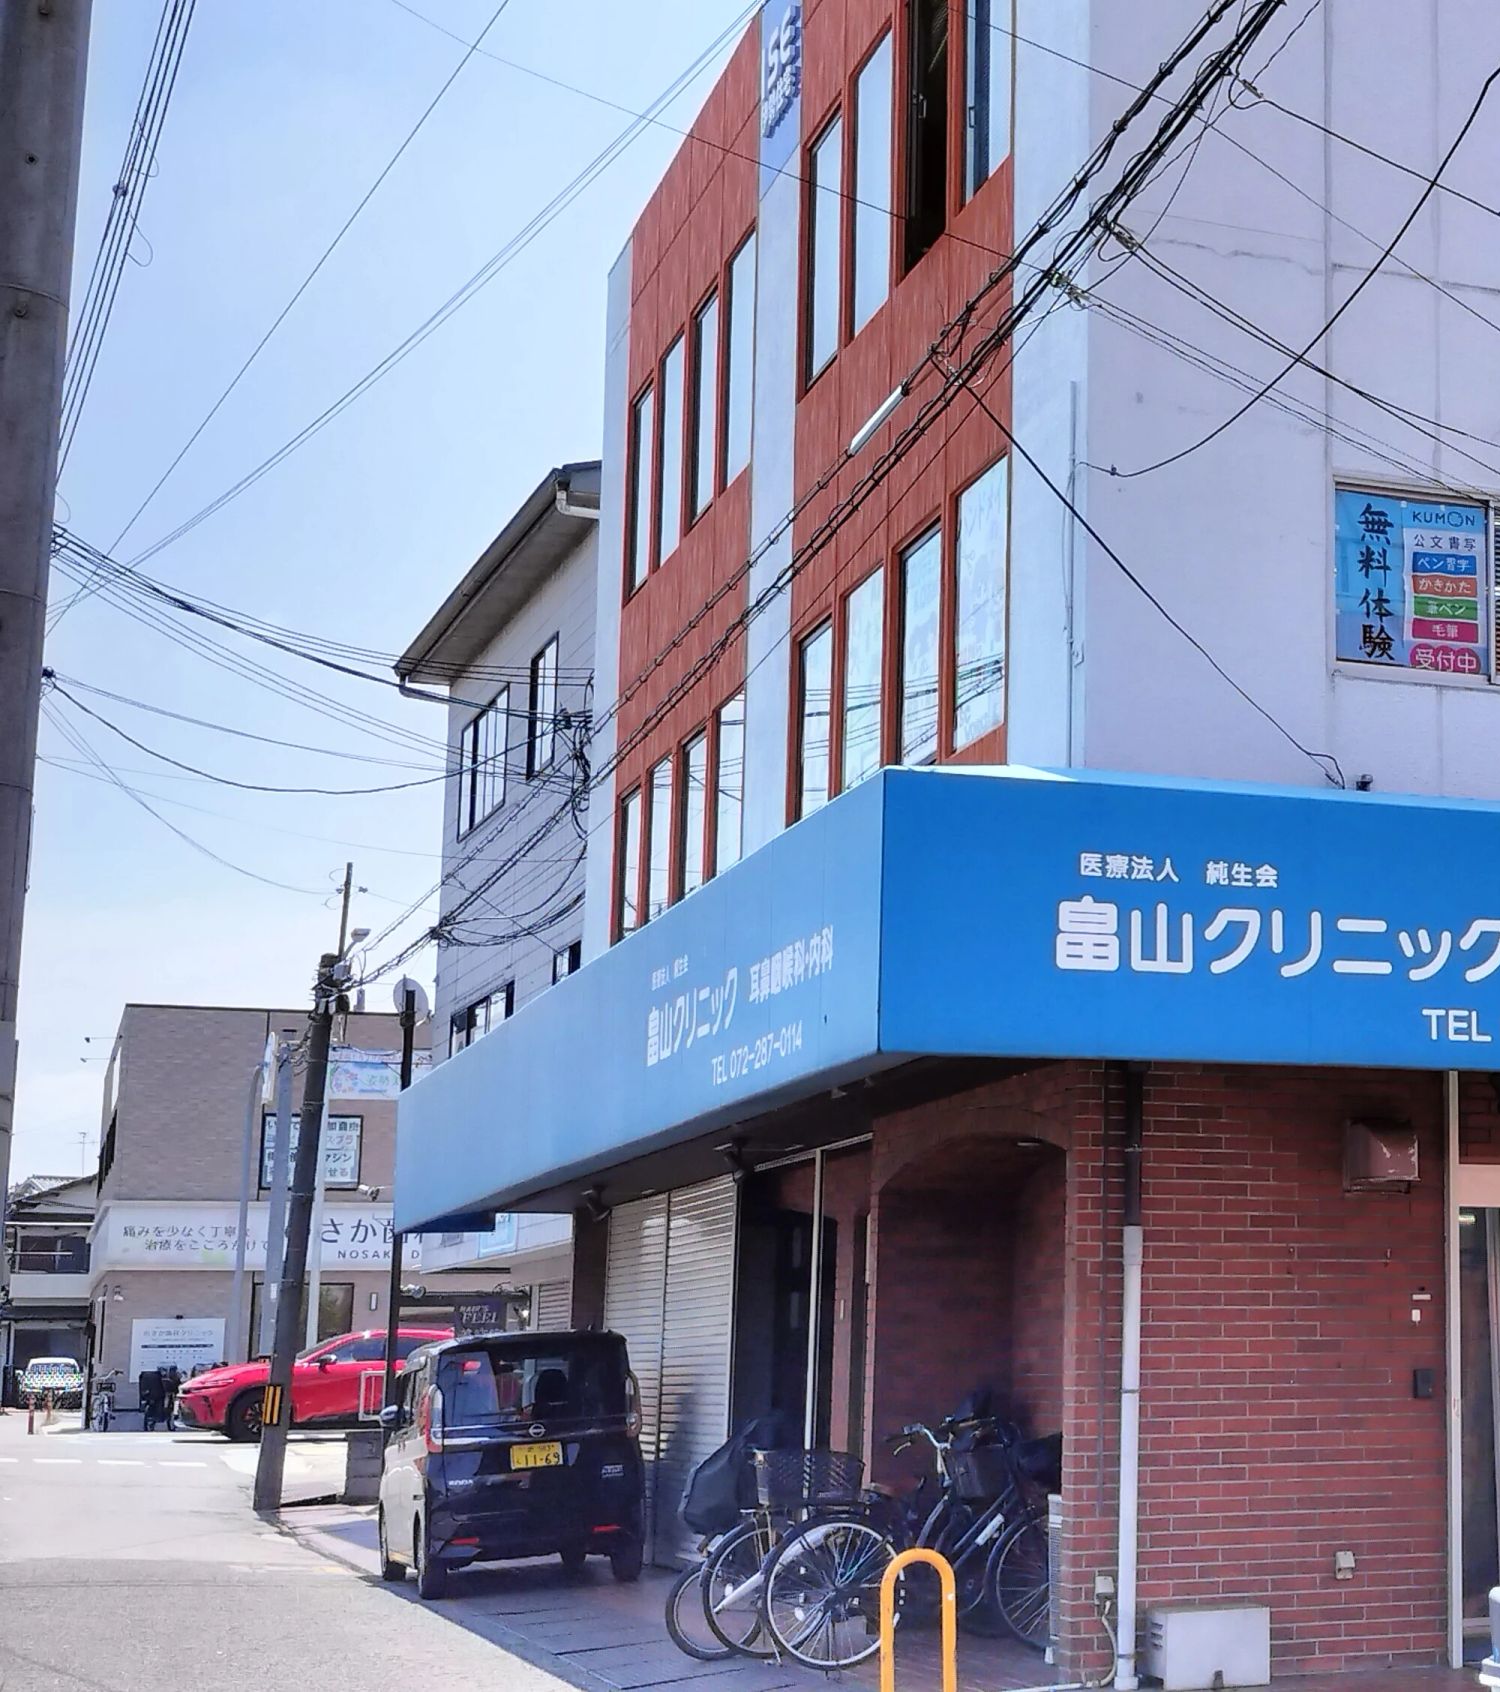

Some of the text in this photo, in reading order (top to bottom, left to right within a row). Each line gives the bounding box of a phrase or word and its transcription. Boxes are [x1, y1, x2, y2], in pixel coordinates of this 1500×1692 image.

[1412, 510, 1475, 528] KUMON
[1414, 534, 1476, 551] 公文書写
[1358, 503, 1395, 661] 無料体験
[1419, 579, 1472, 593] かきかた
[1415, 649, 1477, 673] 受付中
[1080, 852, 1279, 889] 医療法人 純生会
[647, 967, 738, 1067] 畠山クリニック
[1422, 1008, 1492, 1043] TEL
[711, 1020, 802, 1086] TEL 072-287-0114
[525, 1452, 560, 1466] 11-69
